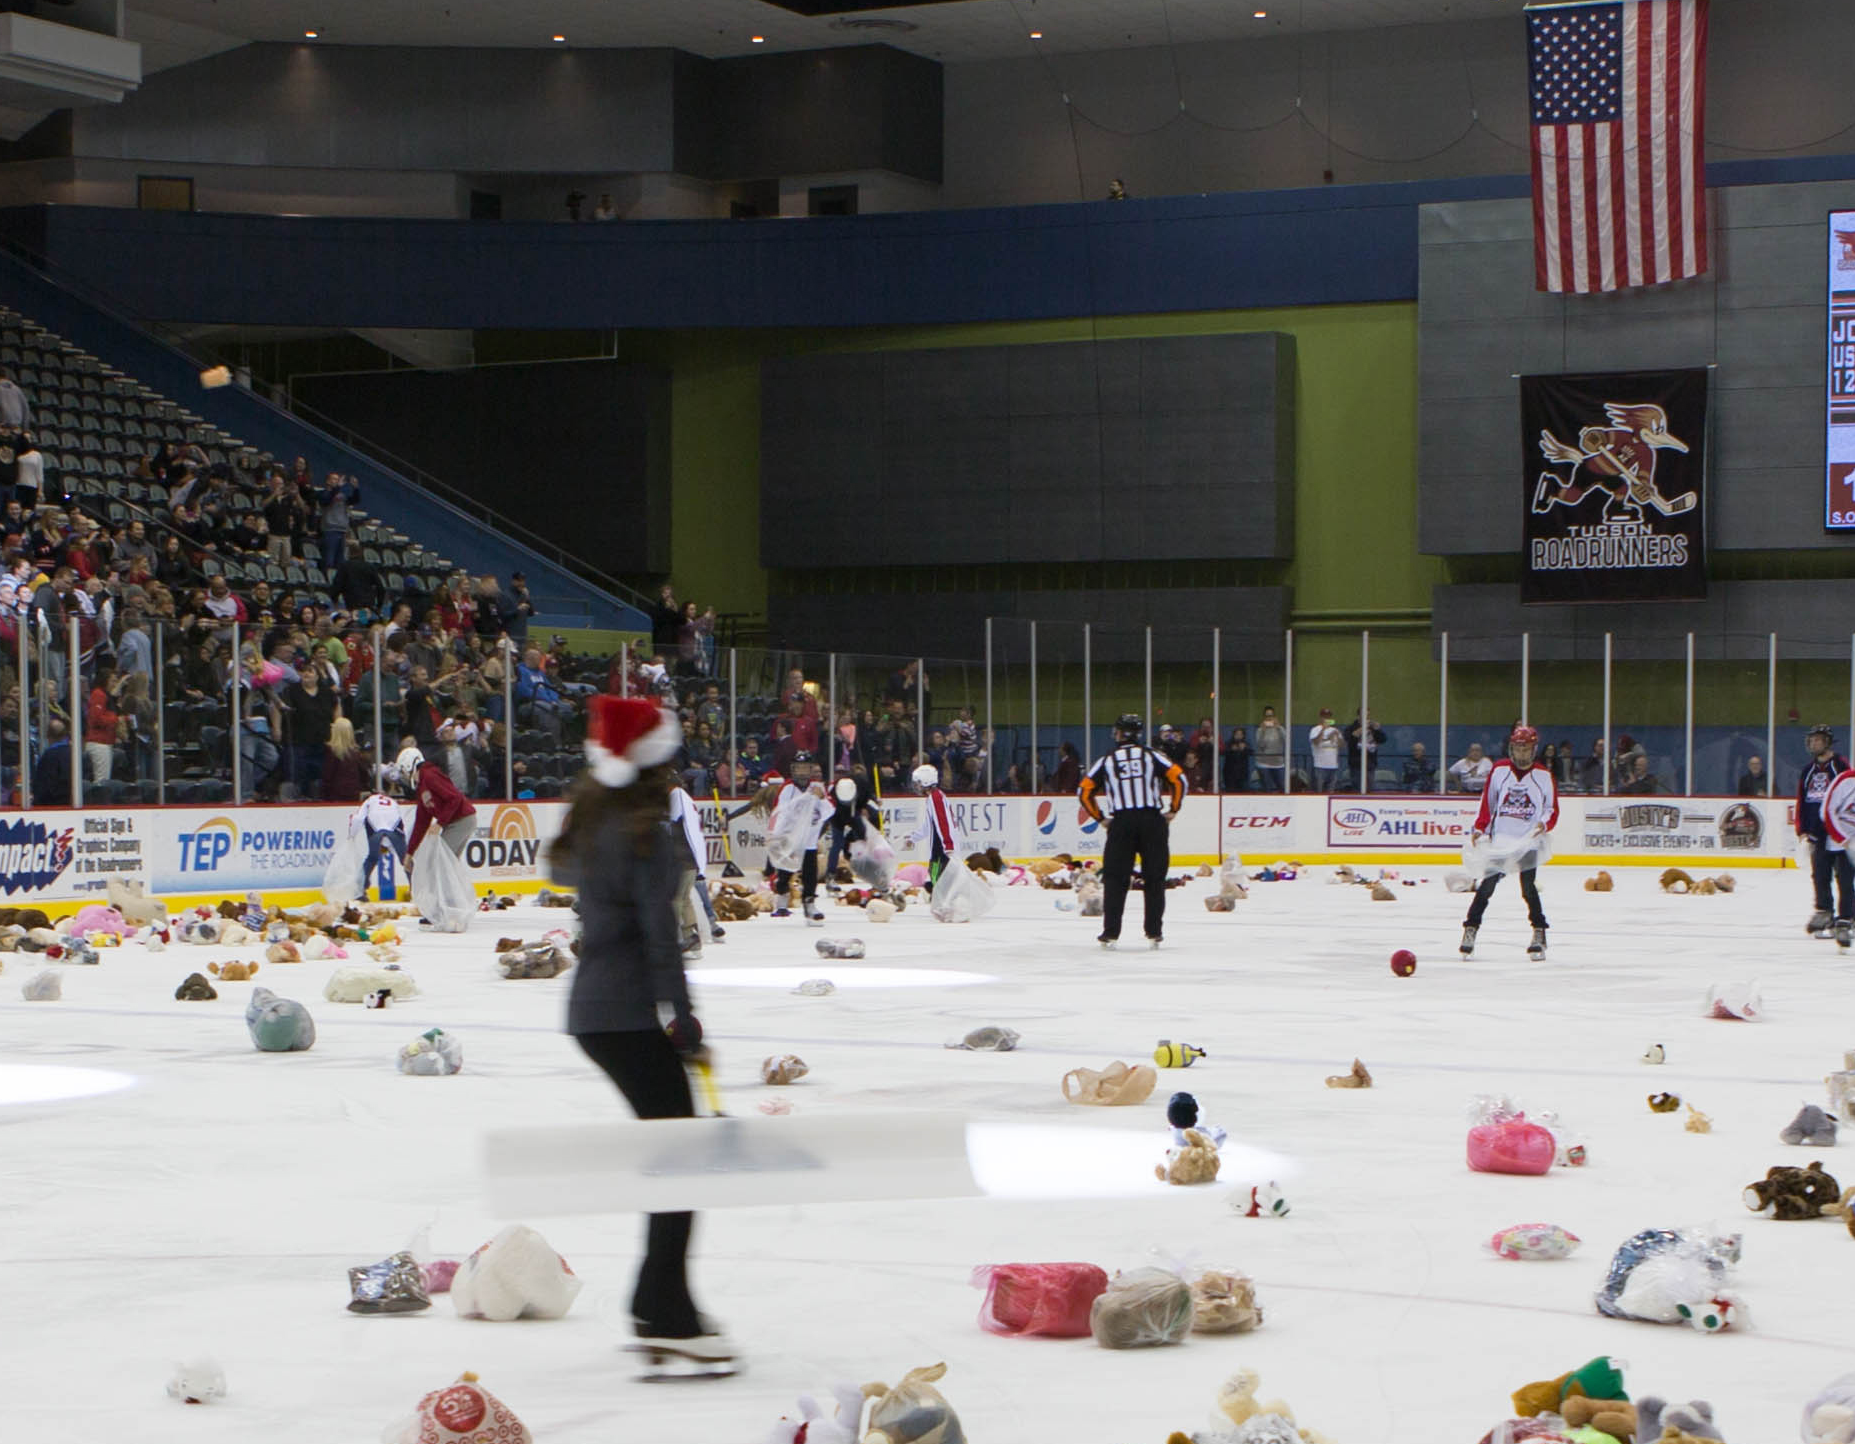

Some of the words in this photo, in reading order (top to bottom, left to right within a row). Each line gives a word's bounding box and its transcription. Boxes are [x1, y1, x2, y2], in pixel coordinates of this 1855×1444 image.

[1833, 345, 1855, 369] US
[1567, 523, 1653, 537] TUCSON
[1531, 533, 1689, 570] ROADRUNNERS
[1118, 760, 1145, 779] 39
[956, 803, 1006, 836] REST
[1227, 816, 1292, 828] CCM
[1343, 813, 1371, 823] AHL
[1377, 820, 1473, 835] AHLlive.
[241, 830, 335, 851] POWERING
[178, 832, 231, 872] TEP
[251, 854, 269, 868] THE
[466, 839, 541, 868] ODAY
